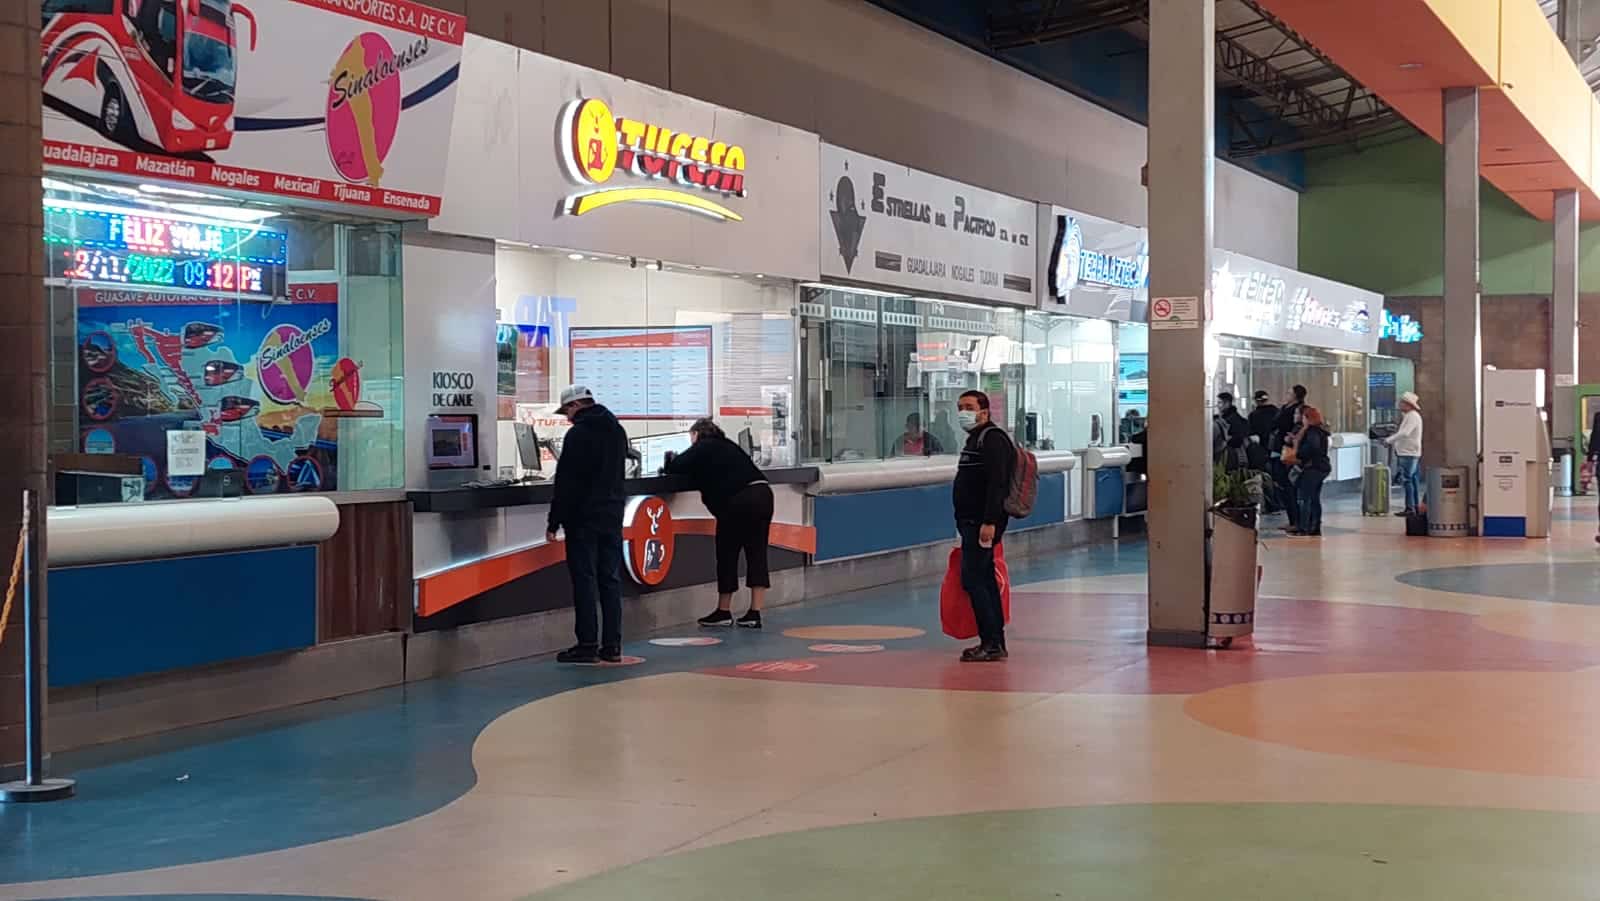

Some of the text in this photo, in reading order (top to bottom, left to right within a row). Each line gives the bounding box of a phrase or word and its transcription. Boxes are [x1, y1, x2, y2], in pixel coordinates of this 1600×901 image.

[400, 8, 417, 27] S.A.
[420, 14, 435, 31] DE
[332, 36, 430, 109] Sinaloenses
[616, 117, 746, 194] TUFESA
[43, 144, 430, 210] uadalajara Mazatlán Nogales Mexicali Tijuana Ensenada
[108, 216, 165, 246] FELIZ
[184, 260, 234, 289] 09:12
[95, 290, 144, 303] GUASAVE
[261, 318, 332, 369] Sinaloenses
[432, 371, 474, 389] KIOSCO
[432, 393, 473, 406] DE CANJE
